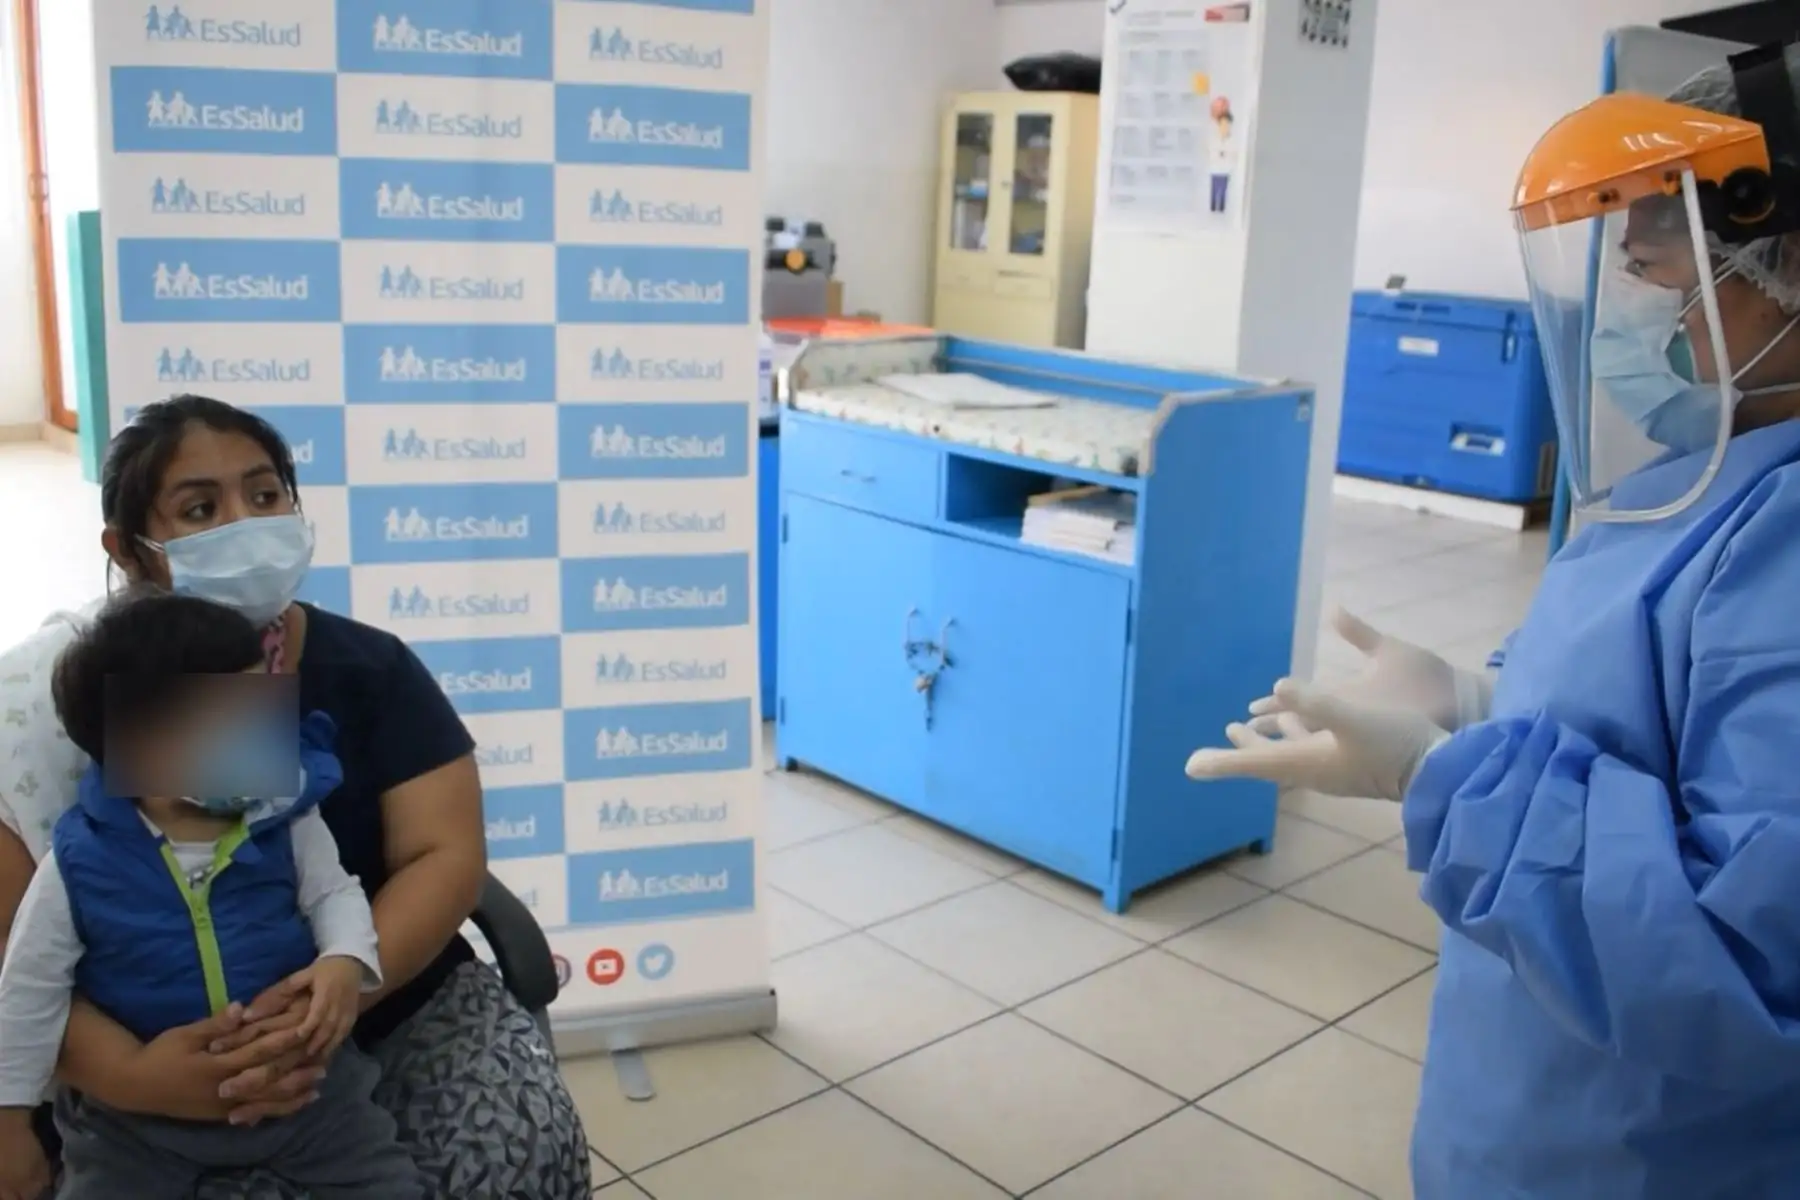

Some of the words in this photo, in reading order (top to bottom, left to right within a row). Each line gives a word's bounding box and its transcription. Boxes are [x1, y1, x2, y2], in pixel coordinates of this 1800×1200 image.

[201, 18, 301, 47] EsSalud
[424, 30, 522, 57] EsSalud
[638, 41, 723, 69] EsSalud
[203, 105, 304, 133] EsSalud
[427, 113, 522, 138] EsSalud
[638, 121, 722, 149] EsSalud
[205, 191, 305, 216] EsSalud
[428, 195, 524, 221] EsSalud
[638, 202, 722, 226] EsSalud
[209, 275, 308, 300] EsSalud
[430, 277, 523, 301] EsSalud
[638, 280, 724, 304] EsSalud
[212, 359, 310, 383] EsSalud
[432, 358, 525, 382] EsSalud
[638, 358, 724, 382] EsSalud
[434, 437, 526, 461] EsSalud
[638, 436, 725, 459] EsSalud
[435, 515, 529, 541] EsSalud
[639, 511, 725, 534] EsSalud
[438, 593, 530, 617] EsSalud
[640, 585, 727, 609] EsSalud
[440, 667, 532, 693] EsSalud
[641, 660, 726, 683] EsSalud
[476, 743, 532, 766] Salud
[641, 730, 728, 756] EsSalud
[643, 801, 727, 827] EsSalud
[485, 814, 535, 841] alud
[644, 870, 728, 897] EsSalud
